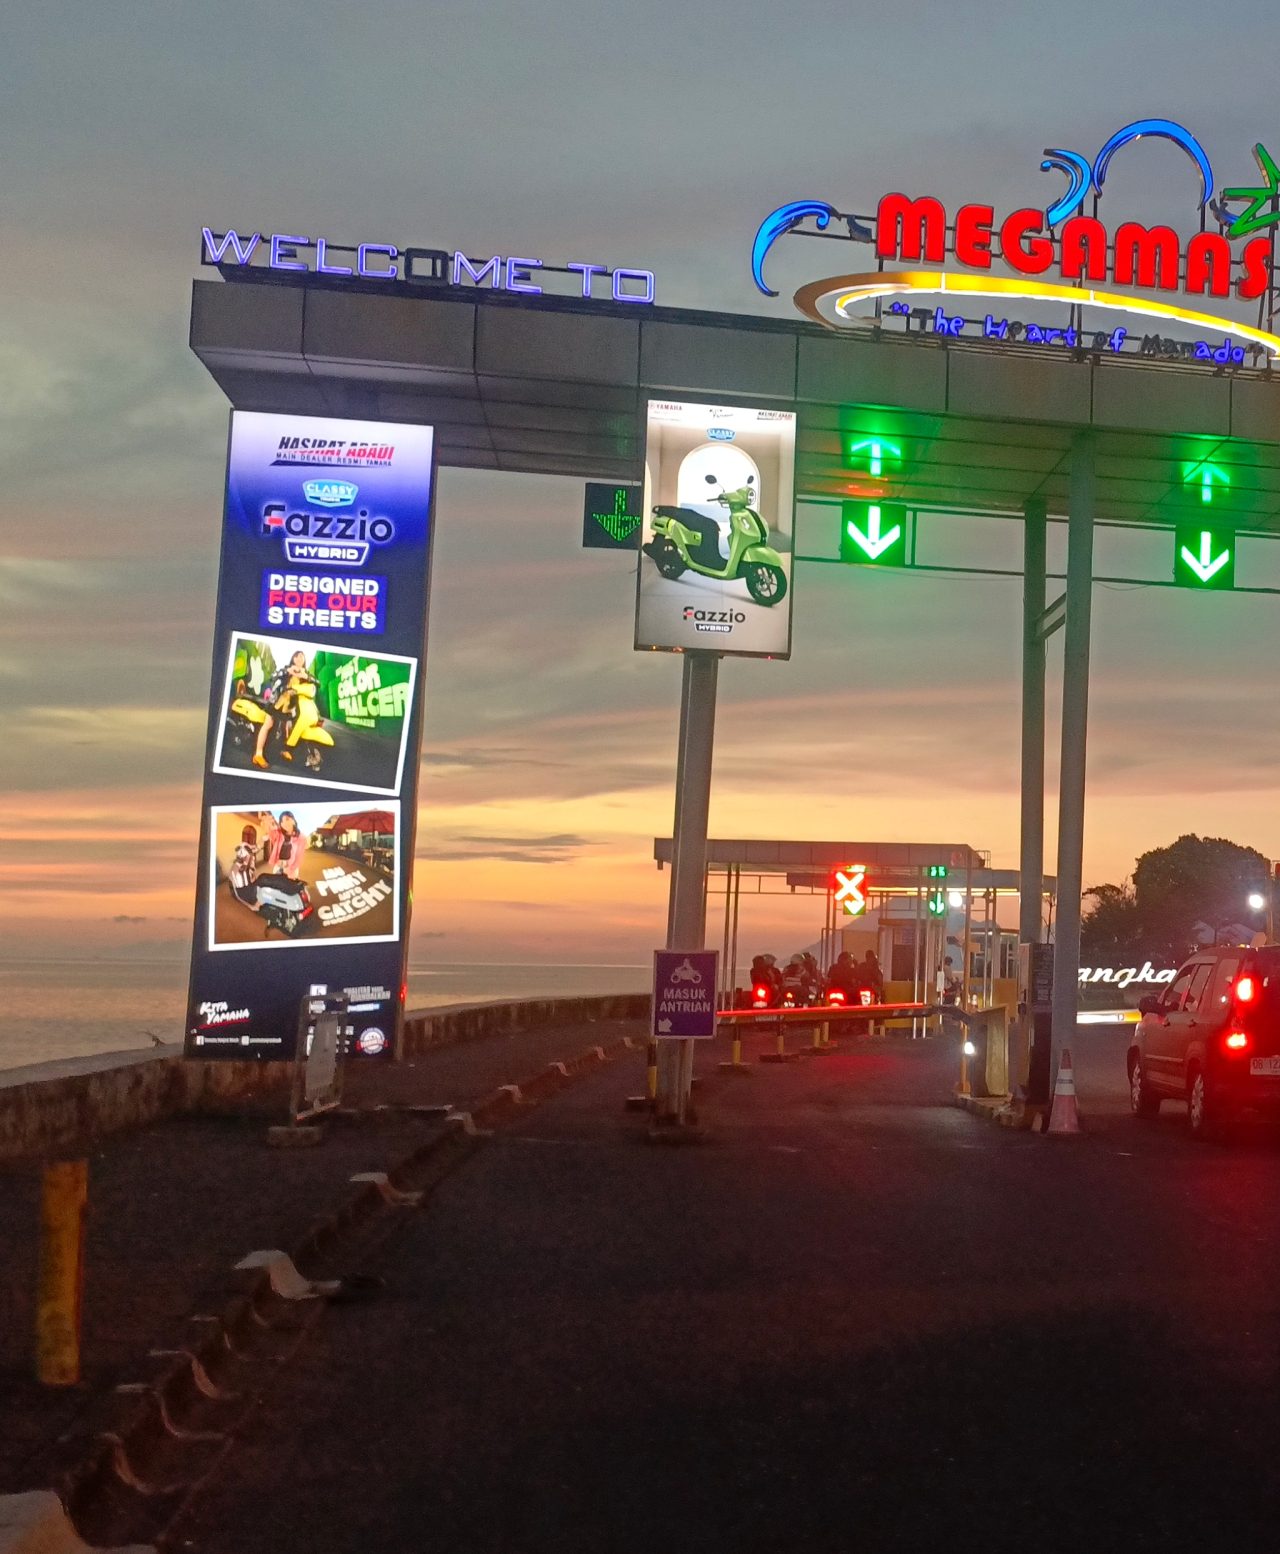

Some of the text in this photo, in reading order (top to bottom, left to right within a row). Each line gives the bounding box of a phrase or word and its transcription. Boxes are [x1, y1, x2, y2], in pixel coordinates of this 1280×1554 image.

[876, 192, 1274, 299] MEGAMAS
[201, 227, 656, 302] WELCOME TO
[984, 314, 1077, 348] Heart
[1093, 327, 1127, 353] of
[300, 454, 332, 462] DEALER
[306, 483, 354, 495] CLASSY
[261, 504, 393, 541] Fazzio
[295, 545, 358, 559] HYBRID
[269, 573, 379, 596] DESIGNED
[269, 590, 377, 612] FOR OUR
[268, 607, 377, 629] STREETS
[683, 606, 746, 623] Fazzio
[318, 879, 392, 920] CATCHY
[663, 988, 706, 999] MASUK
[206, 1008, 250, 1025] YAMAHA
[660, 1001, 711, 1012] ANTRIAN
